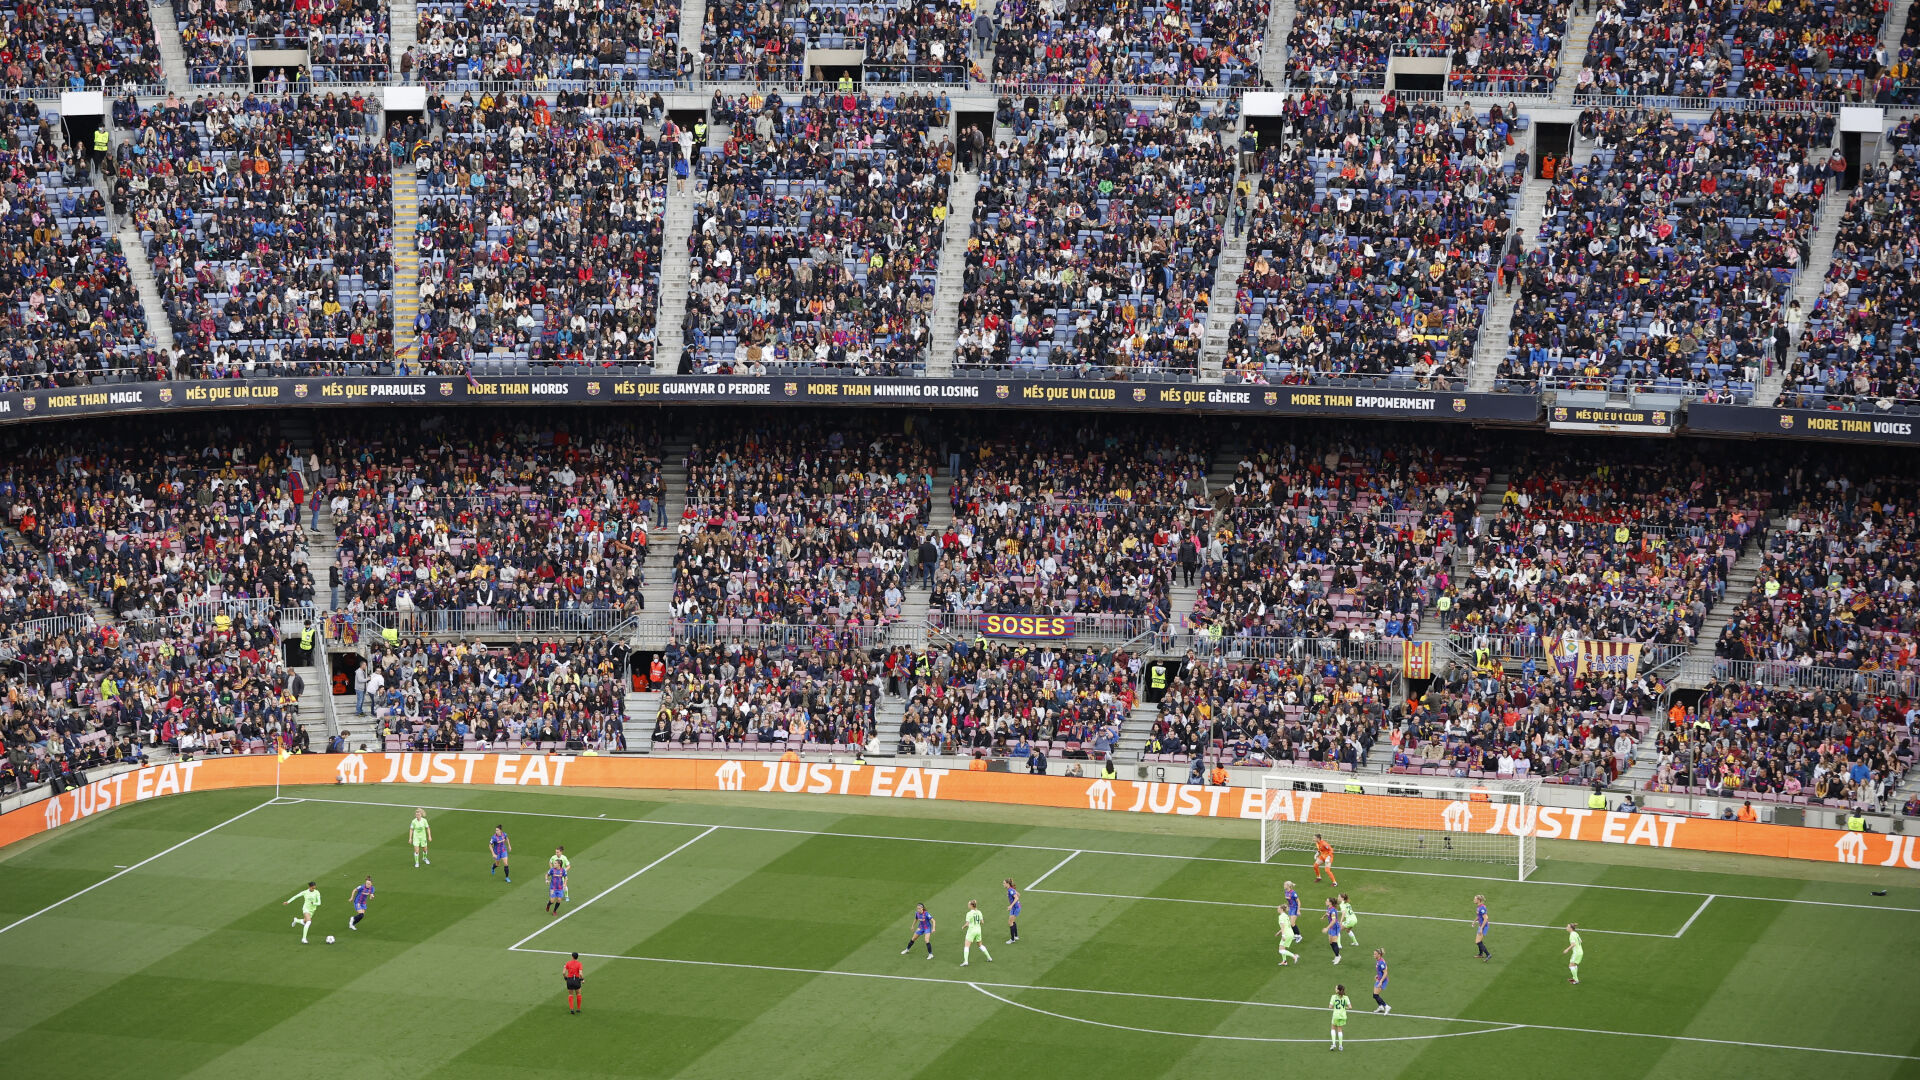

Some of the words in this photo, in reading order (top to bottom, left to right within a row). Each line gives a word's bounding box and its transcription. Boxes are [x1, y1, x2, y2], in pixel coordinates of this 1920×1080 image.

[185, 385, 207, 400] MÉS
[208, 387, 232, 402] QUE
[233, 386, 249, 398] UN
[251, 386, 279, 397] CLUB
[322, 382, 343, 396] MÉS
[345, 384, 368, 399] QUE
[370, 384, 426, 396] PARAULES
[468, 383, 498, 395] MORE
[500, 383, 529, 395] THAN
[531, 383, 569, 395] WORDS
[614, 380, 636, 394] MÉS
[637, 383, 660, 397] QUE
[662, 383, 715, 394] GUANYAR
[717, 383, 726, 394] O
[728, 383, 771, 395] PERDRE
[807, 383, 838, 395] MORE
[842, 384, 872, 396] THAN
[873, 385, 921, 396] WINNING
[923, 385, 939, 397] OR
[941, 386, 979, 398] LOSING
[1023, 384, 1044, 398] MÉS
[1046, 387, 1069, 401] QUE
[1071, 388, 1087, 399] UN
[1088, 388, 1116, 400] CLUB
[1160, 387, 1181, 402] MÉS
[1183, 391, 1206, 405] QUE
[1208, 388, 1250, 404] GÈNERE
[48, 395, 78, 408] MORE
[79, 393, 108, 406] THAN
[109, 391, 143, 404] MAGIC
[1291, 393, 1322, 406] MORE
[1323, 395, 1353, 407] THAN
[1355, 396, 1436, 410] EMPOWERMENT
[1575, 409, 1591, 420] MÉS
[1592, 412, 1610, 422] QUE
[1623, 413, 1645, 422] CLUB
[1807, 417, 1839, 431] MORE
[1840, 419, 1872, 433] THAN
[1873, 421, 1912, 435] VOICES
[987, 615, 1066, 635] SOSES
[1605, 654, 1636, 664] SOSES
[381, 752, 486, 784] JUST
[494, 755, 576, 786] EAT
[758, 761, 861, 795] JUST
[870, 766, 949, 799] EAT
[70, 774, 130, 822] JUST
[136, 761, 202, 800] EAT
[1128, 782, 1233, 817] JUST
[1240, 788, 1322, 823] EAT
[1484, 804, 1595, 840] JUST
[1602, 812, 1687, 848] EAT
[1335, 999, 1346, 1010] 24
